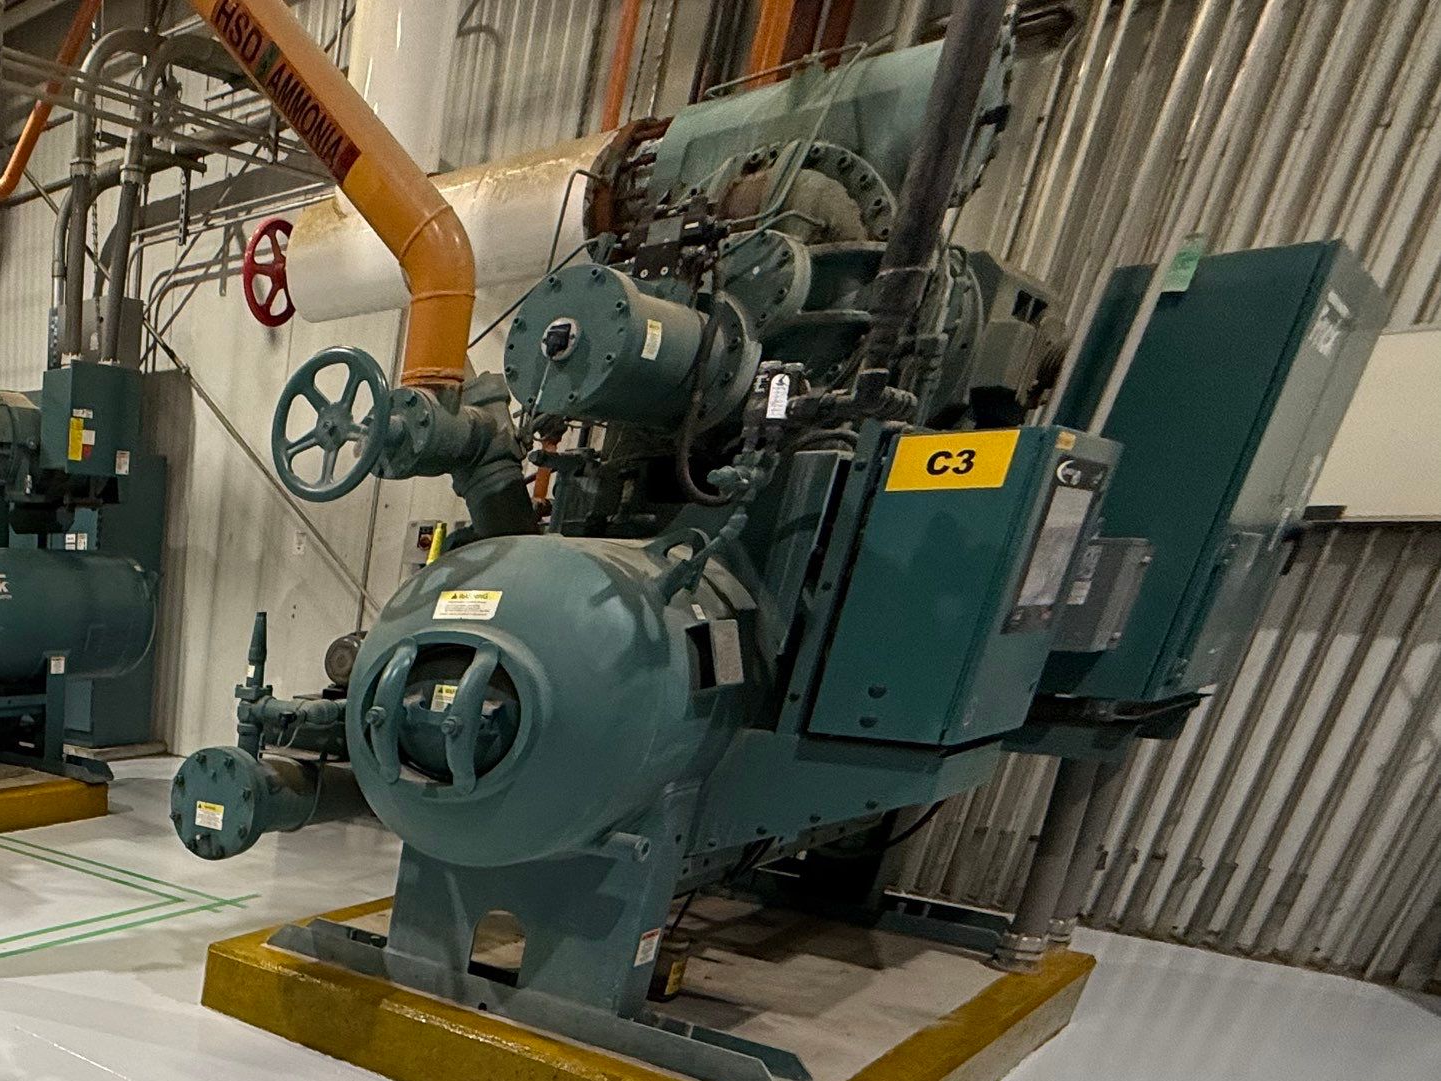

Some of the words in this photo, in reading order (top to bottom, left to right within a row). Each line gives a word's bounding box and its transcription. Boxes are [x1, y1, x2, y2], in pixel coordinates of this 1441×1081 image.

[215, 0, 263, 64] HSD
[267, 63, 344, 168] AMMONIA
[926, 449, 977, 476] C3
